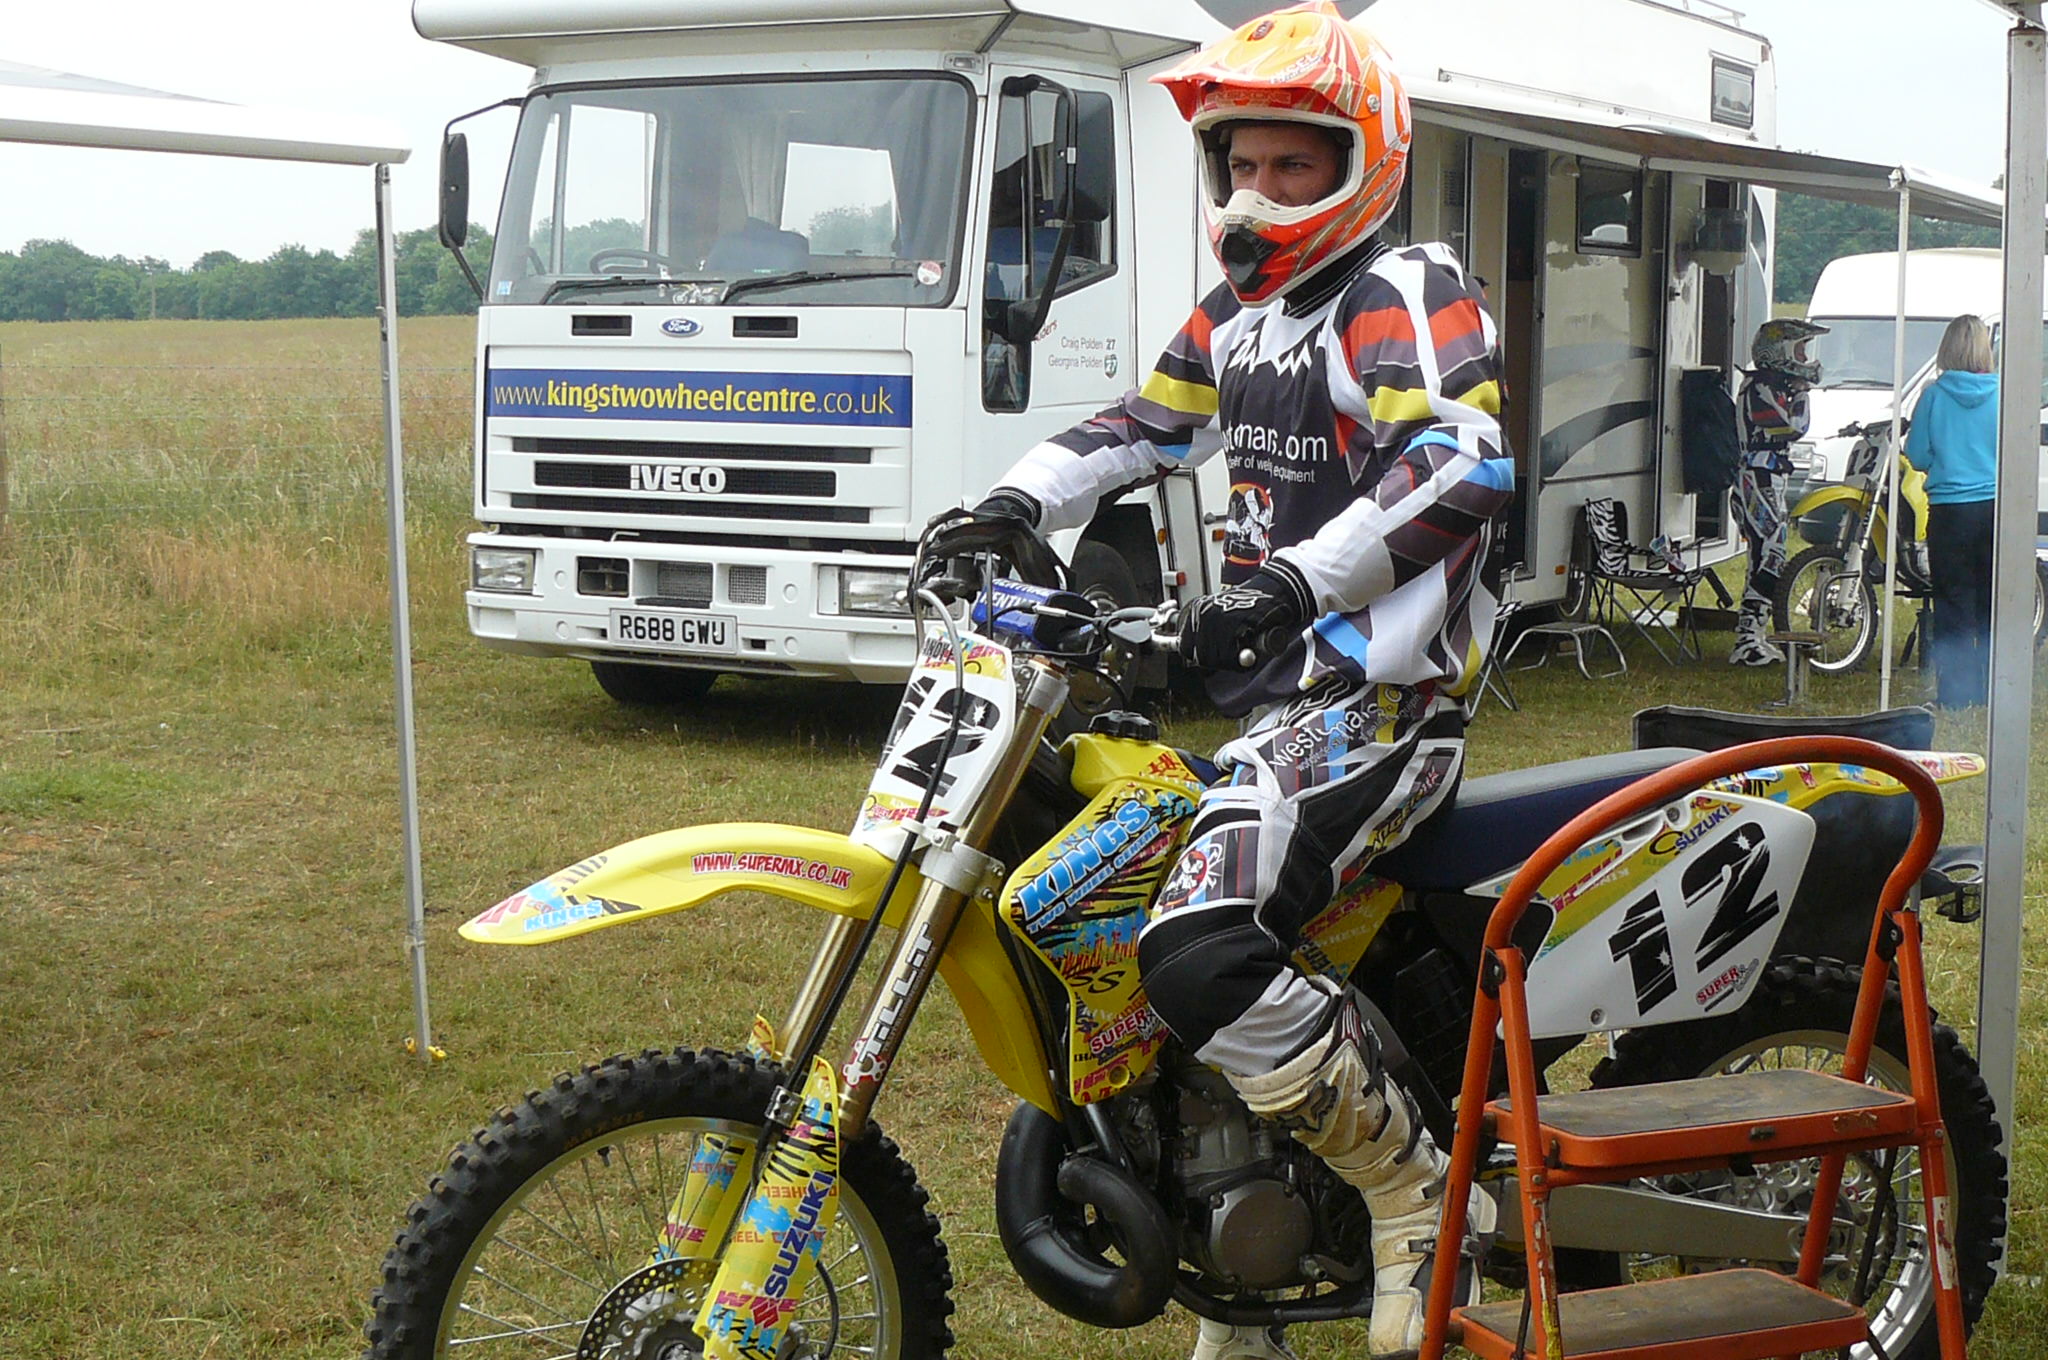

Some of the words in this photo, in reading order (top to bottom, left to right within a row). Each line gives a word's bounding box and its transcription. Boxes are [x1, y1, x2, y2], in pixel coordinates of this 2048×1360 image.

[1048, 354, 1079, 370] Georgina
[1080, 355, 1103, 368] Polden
[1061, 336, 1080, 351] Craig
[1080, 337, 1103, 350] Polden
[494, 380, 894, 416] www.kingstwowheelcentre.co.uk
[630, 464, 726, 494] IVECO
[620, 615, 675, 642] R688
[682, 619, 725, 645] GWU
[1674, 804, 1732, 852] SUZUKI
[691, 852, 854, 890] WWW.SUPERMX.CO.UK
[1017, 800, 1151, 921] KINGS
[1026, 902, 1067, 934] TWO
[1067, 864, 1115, 908] WHEEL
[1113, 823, 1161, 870] CENTRE
[525, 901, 603, 933] KINGS
[1608, 821, 1781, 1017] 12
[1696, 965, 1740, 1005] SUPER
[1090, 1007, 1151, 1054] SUPER
[763, 1169, 835, 1300] SUZUKI
